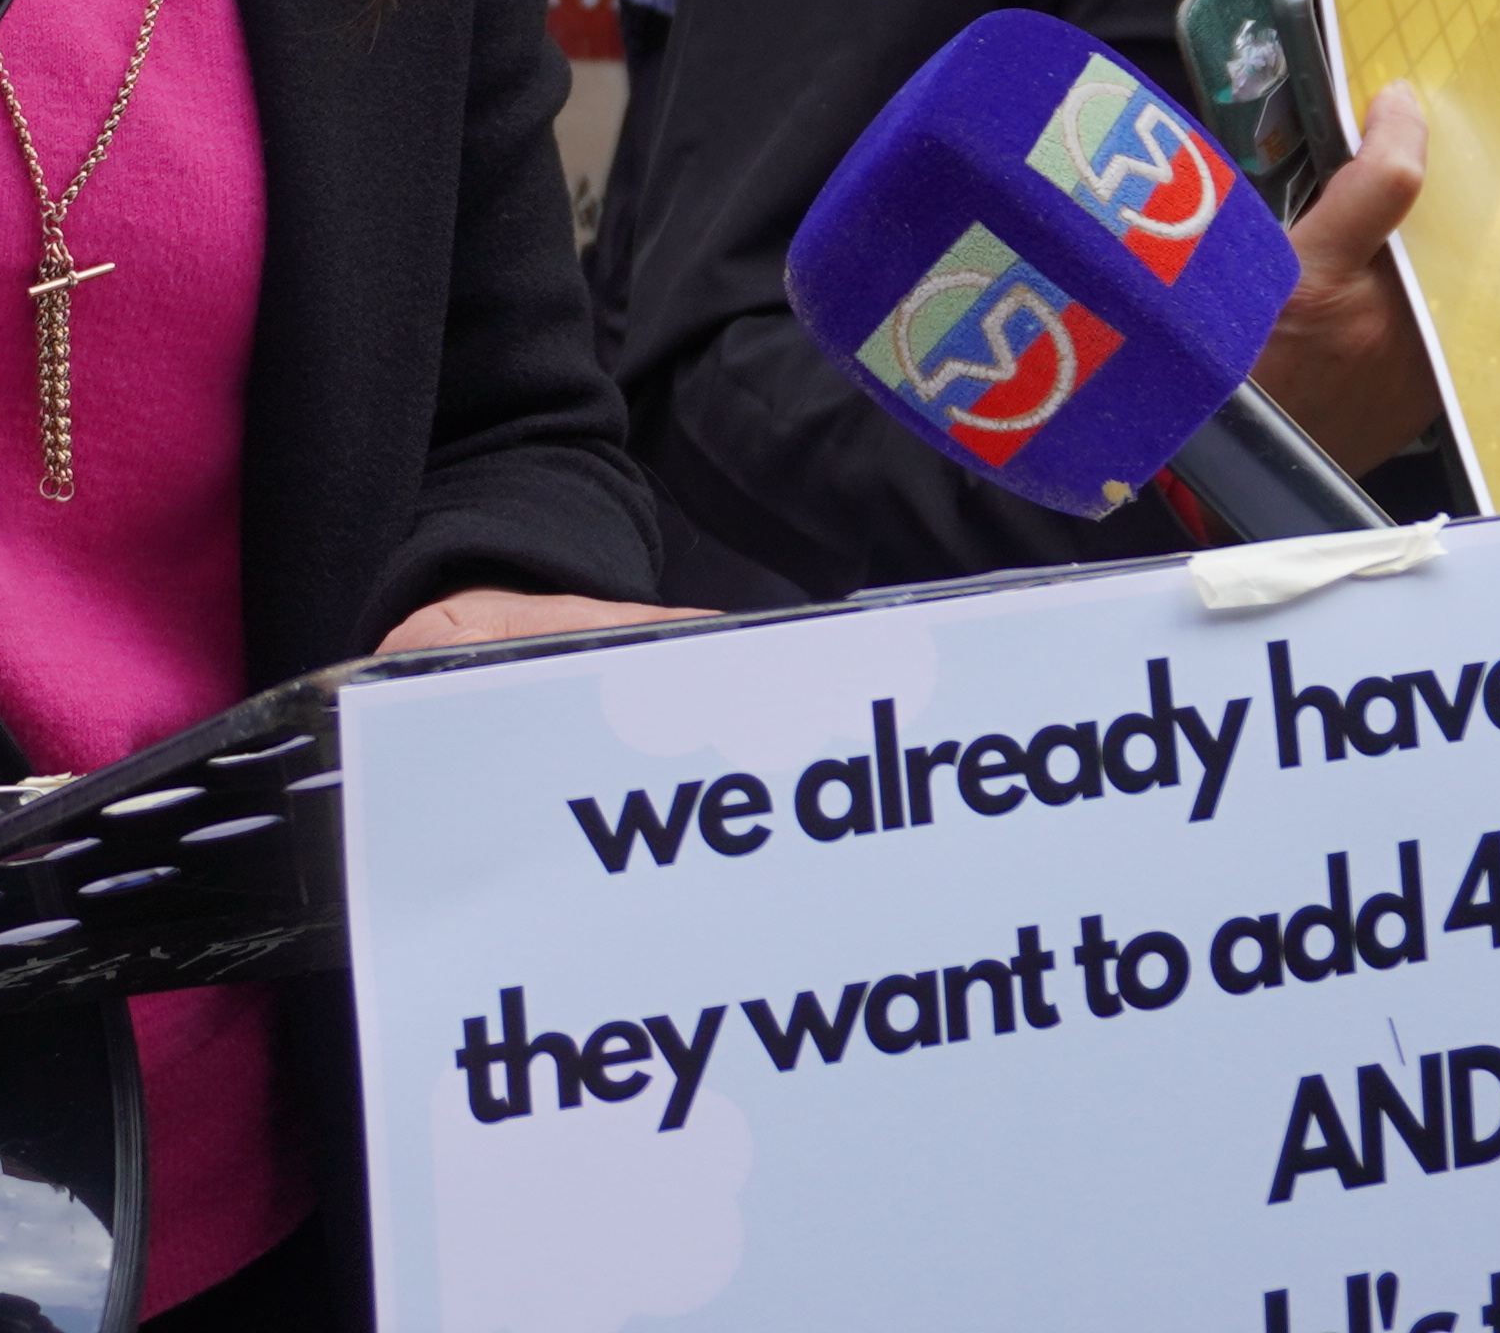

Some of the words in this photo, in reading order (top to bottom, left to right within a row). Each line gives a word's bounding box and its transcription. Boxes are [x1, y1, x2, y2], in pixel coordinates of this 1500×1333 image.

[567, 764, 774, 874] we
[790, 658, 1252, 843] already
[454, 986, 729, 1133] they
[737, 922, 1058, 1072] want
[1072, 911, 1193, 1021] to
[1207, 841, 1426, 996] add
